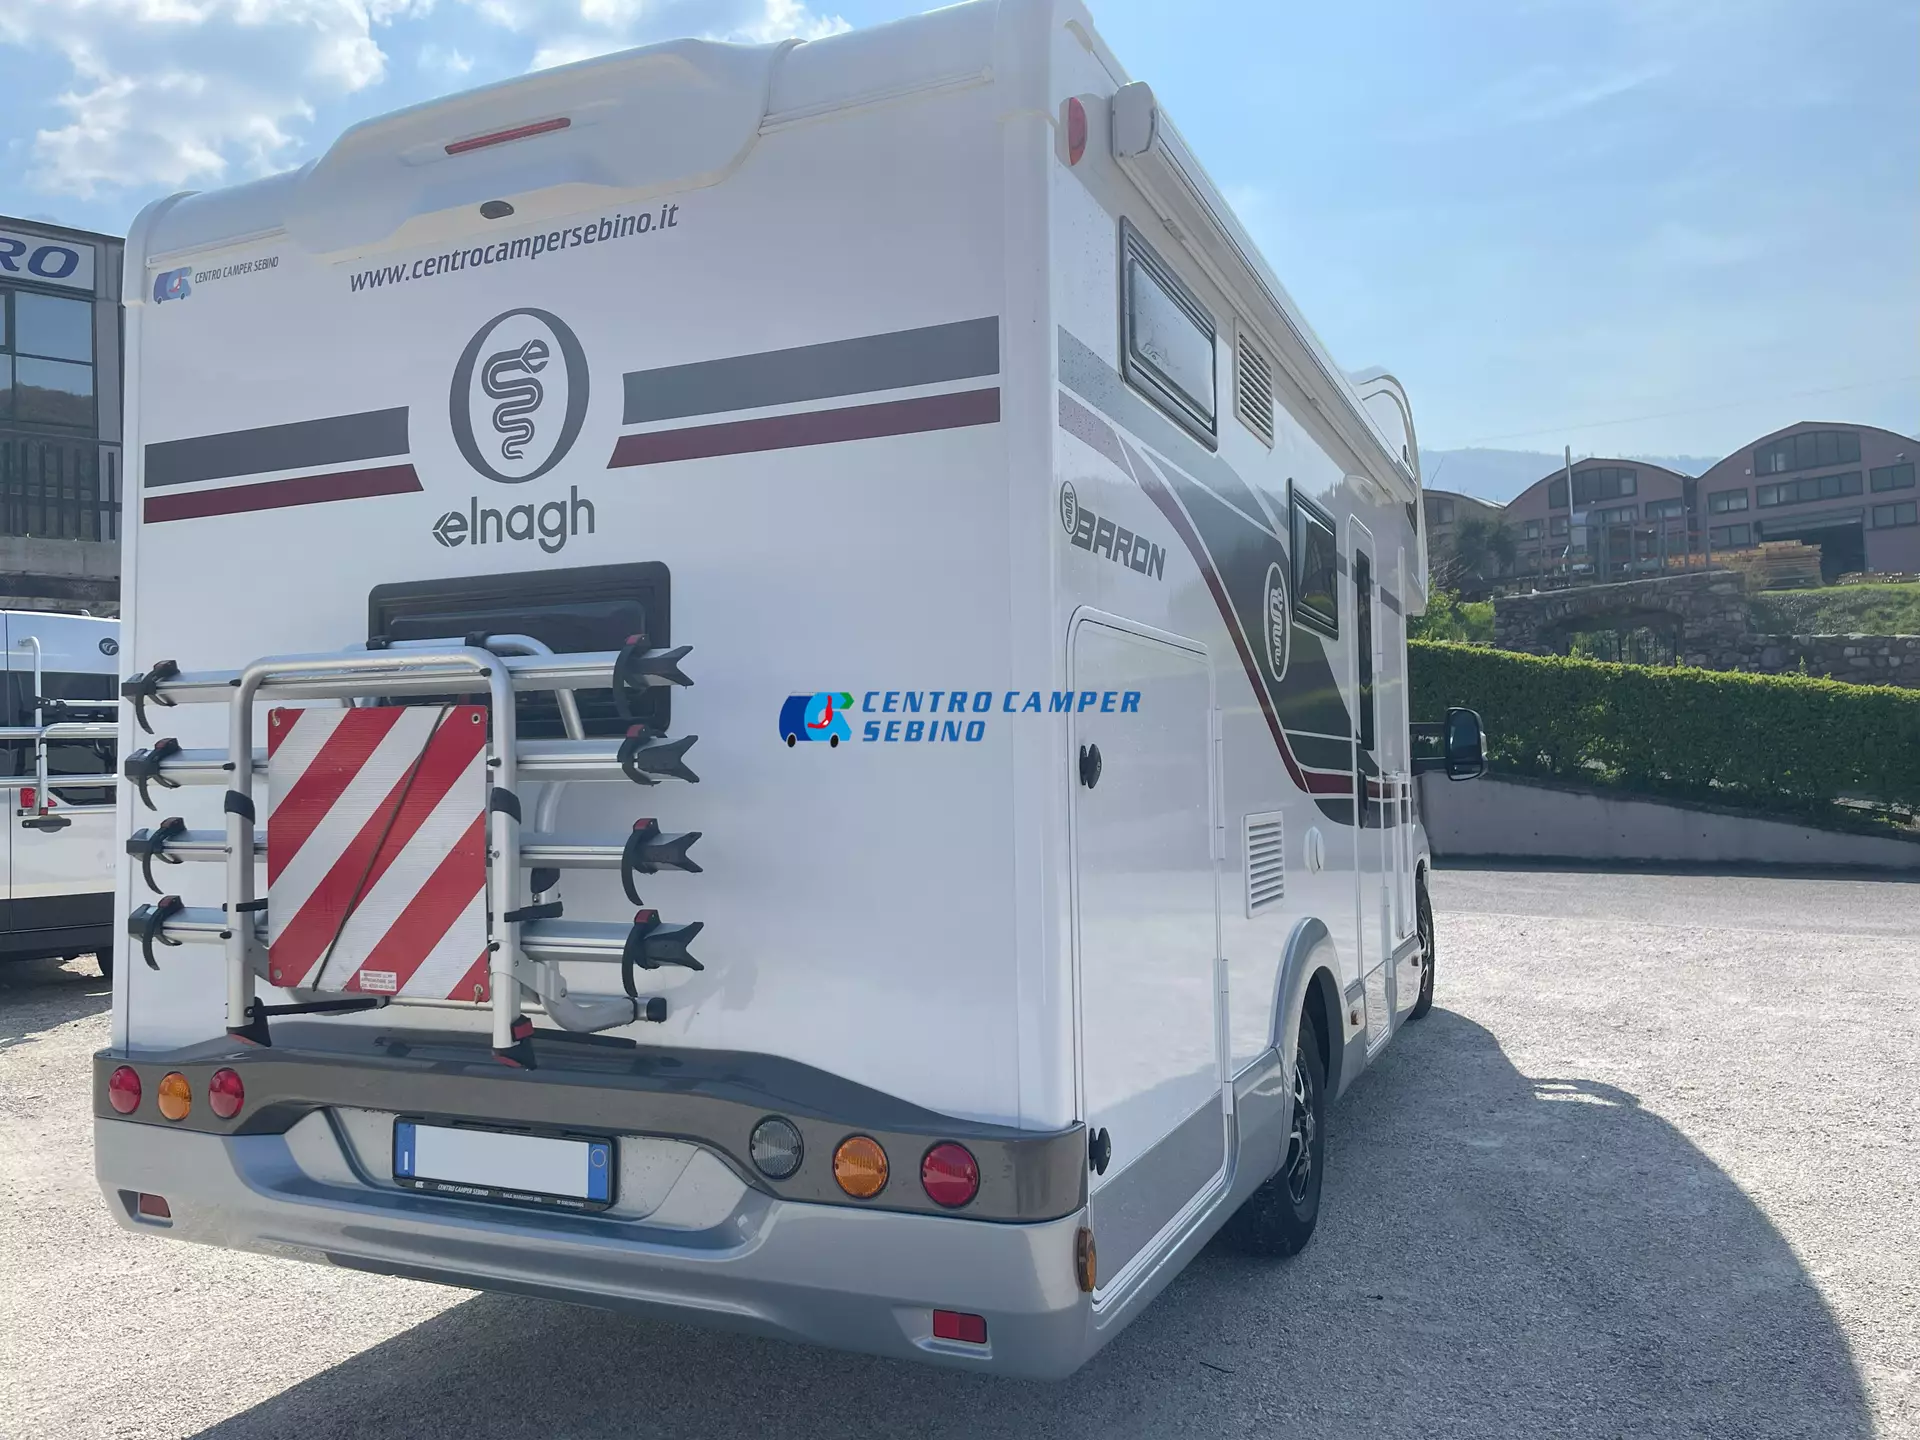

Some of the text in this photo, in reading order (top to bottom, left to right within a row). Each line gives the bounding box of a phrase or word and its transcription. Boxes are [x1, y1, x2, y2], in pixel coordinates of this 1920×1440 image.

[194, 256, 279, 284] CENTRO CAMPER SEBINO
[350, 193, 679, 293] www.centrocampersebino.it
[432, 485, 595, 554] elnagh
[1070, 506, 1167, 581] BARON
